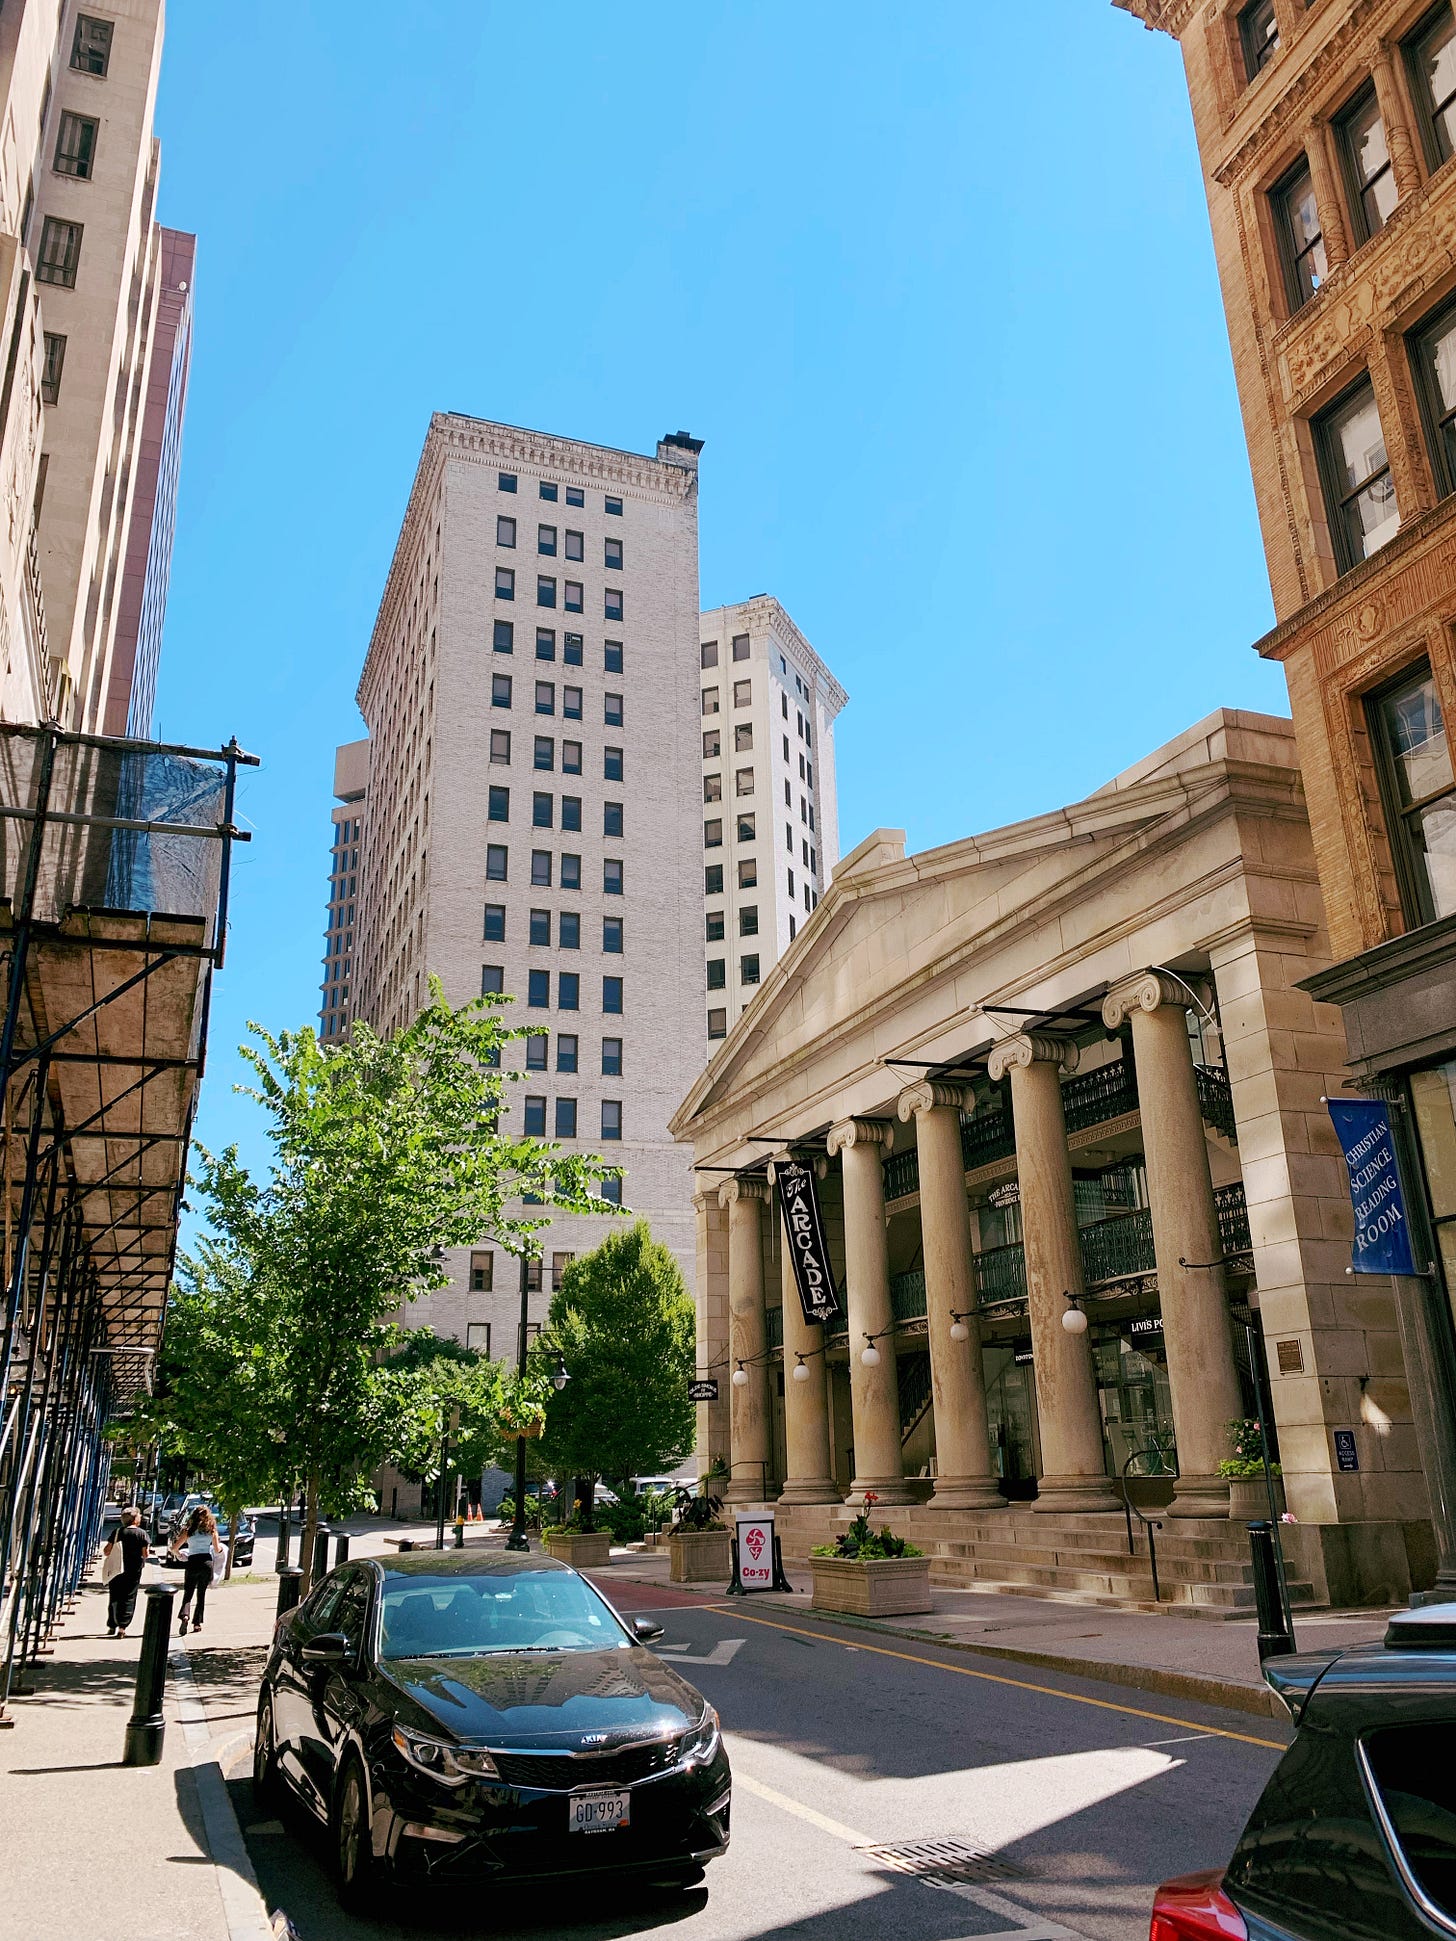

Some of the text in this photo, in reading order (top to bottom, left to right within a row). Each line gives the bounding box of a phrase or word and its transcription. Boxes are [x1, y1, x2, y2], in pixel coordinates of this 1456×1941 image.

[1345, 1120, 1388, 1165] CHRISTIAN
[785, 1178, 807, 1198] The
[1350, 1147, 1393, 1193] SCIENCE
[988, 1188, 1001, 1203] THE
[1000, 1183, 1019, 1195] ARCA
[1354, 1175, 1397, 1221] READING
[790, 1195, 827, 1305] ARCADE
[1355, 1203, 1402, 1253] ROOM
[576, 1800, 623, 1823] GD-993
